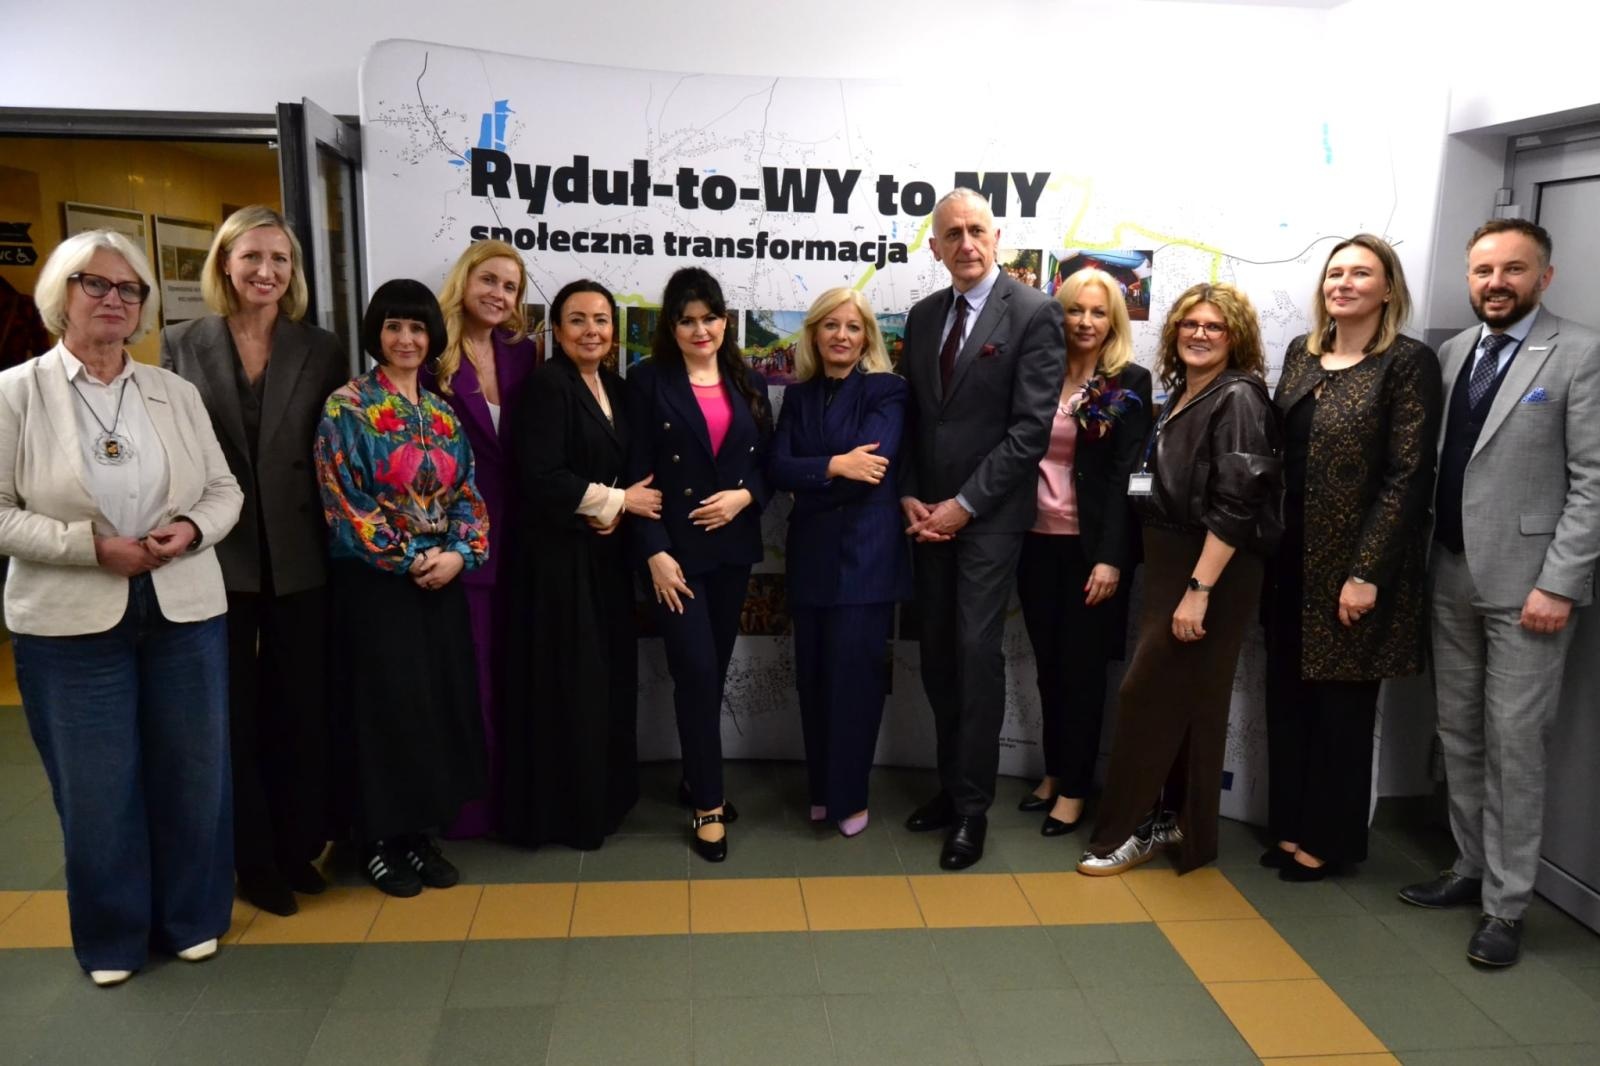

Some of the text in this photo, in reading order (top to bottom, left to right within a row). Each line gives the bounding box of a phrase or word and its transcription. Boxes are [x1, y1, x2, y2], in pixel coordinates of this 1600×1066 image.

[470, 148, 862, 215] Ryduł-to-WY
[876, 174, 936, 217] to
[663, 231, 908, 264] transformacja
